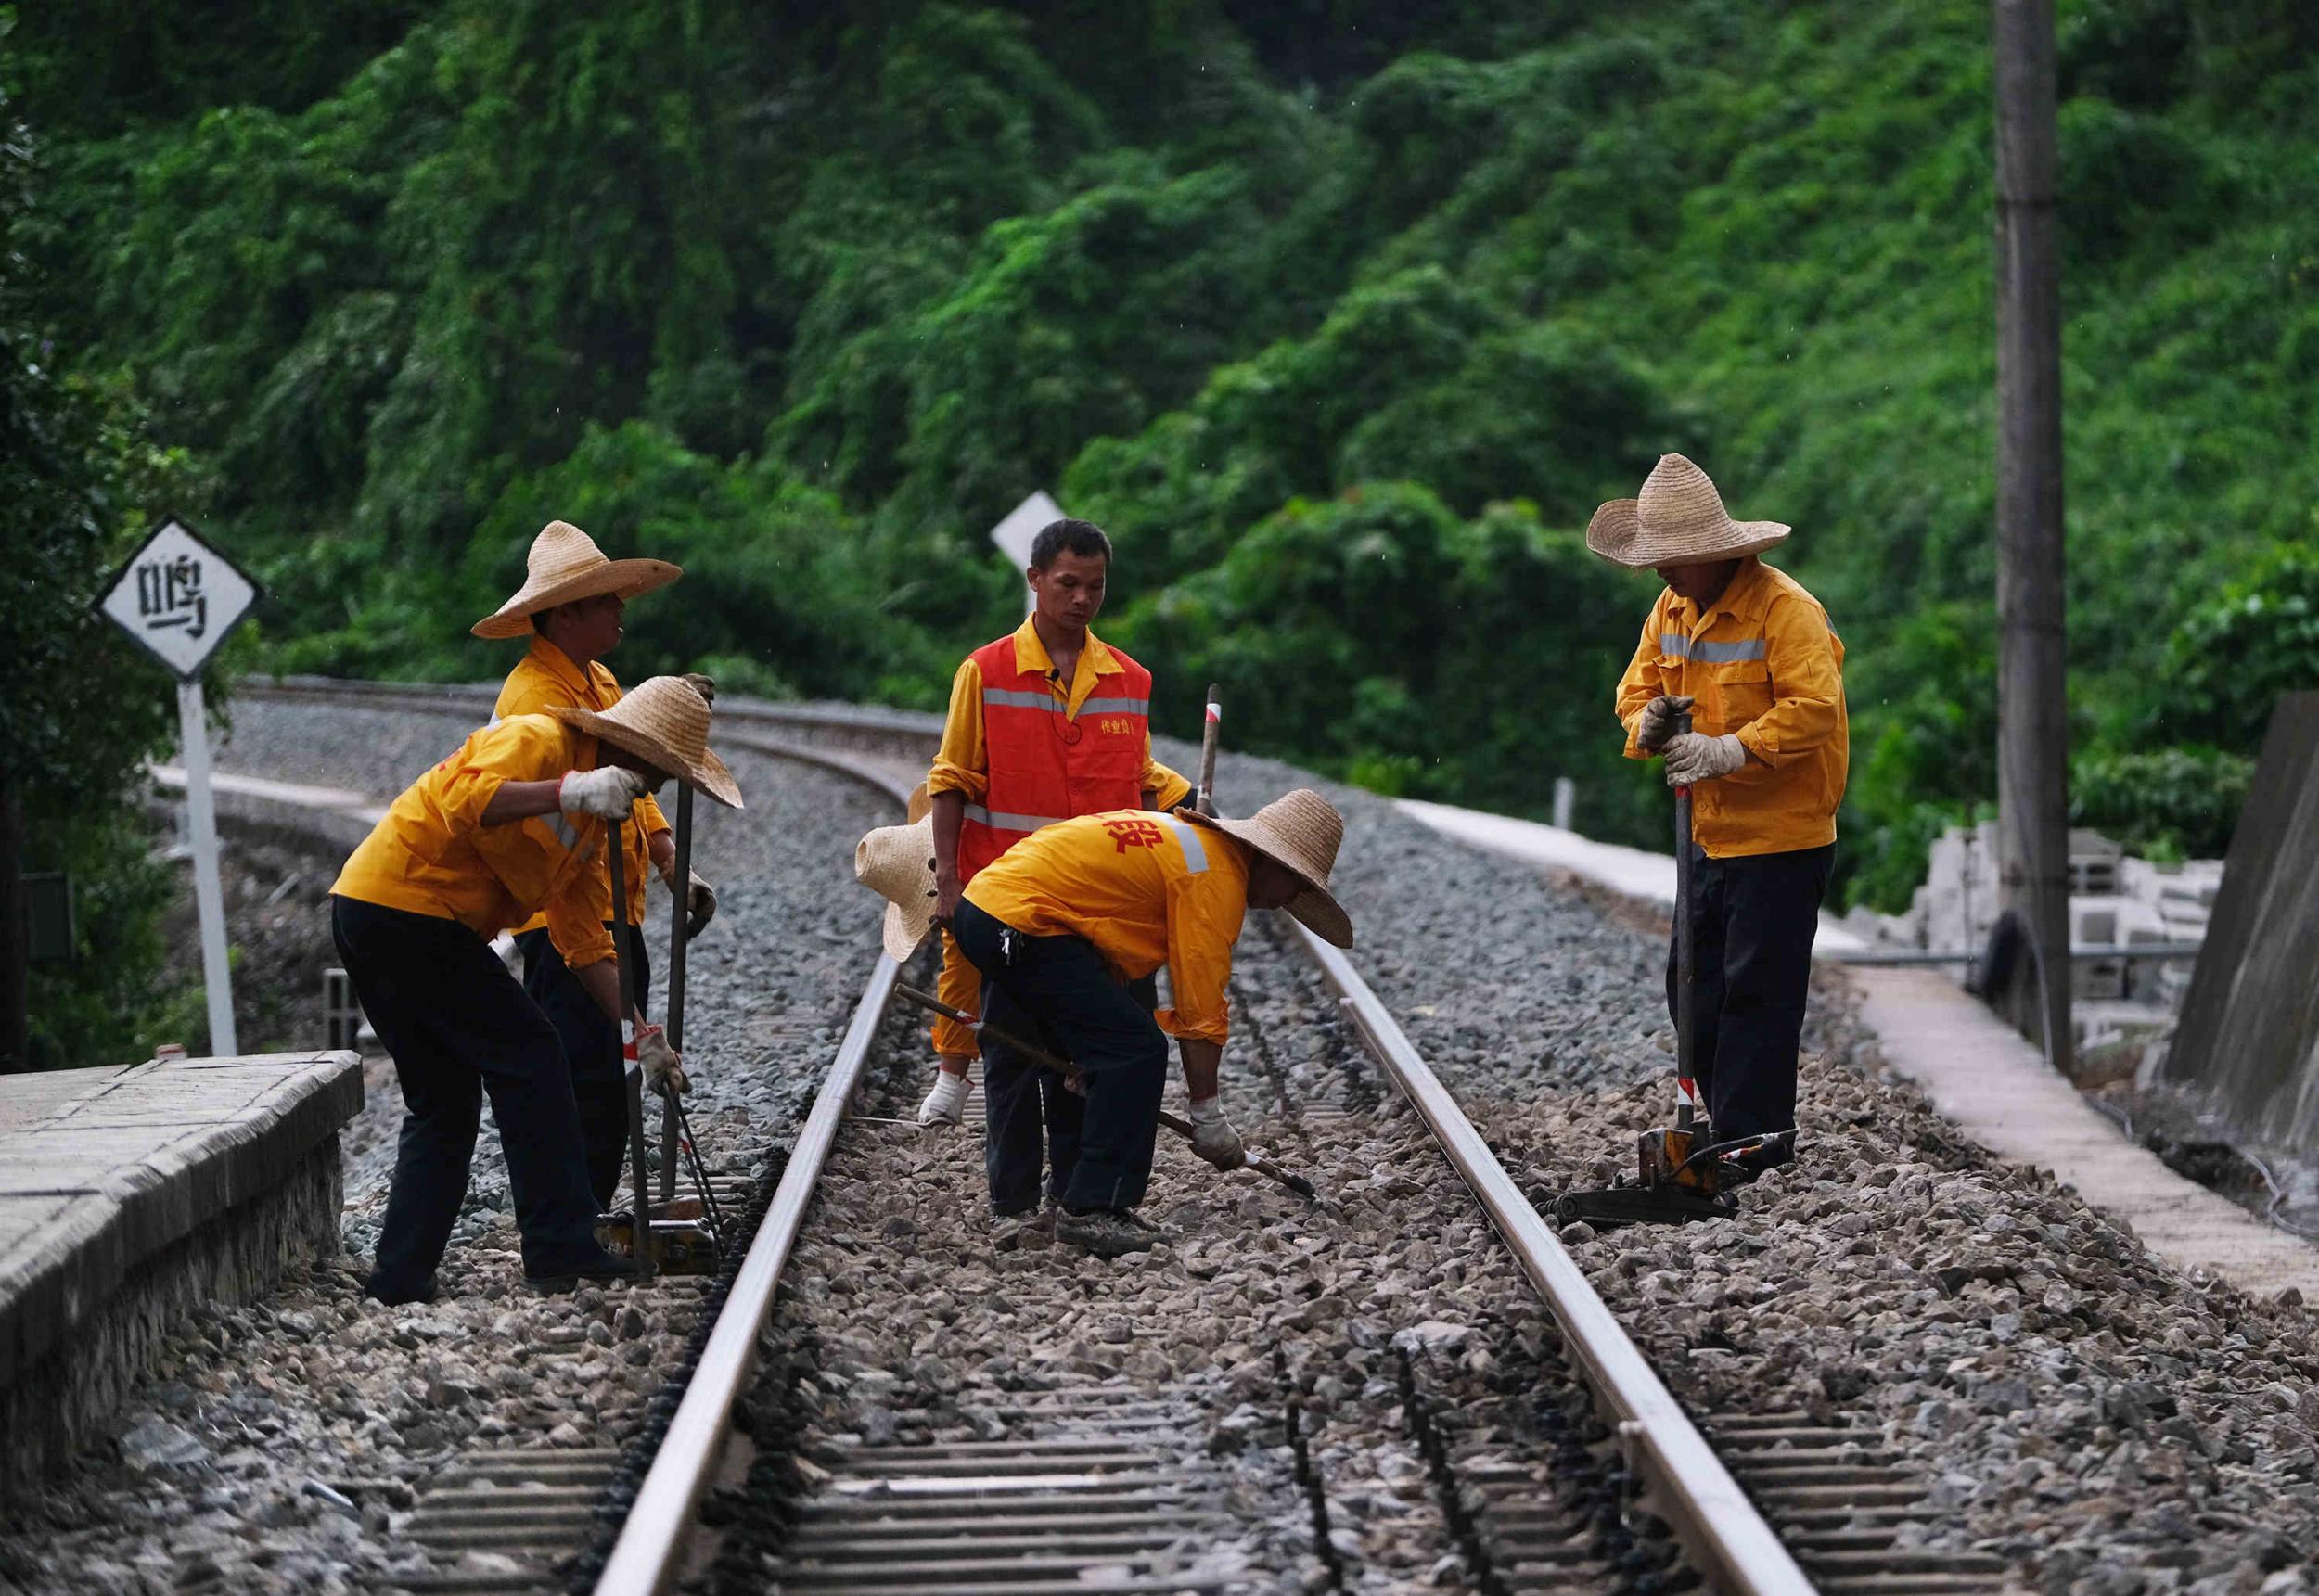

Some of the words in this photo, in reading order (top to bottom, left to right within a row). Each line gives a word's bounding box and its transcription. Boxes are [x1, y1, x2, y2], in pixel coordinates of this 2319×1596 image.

[138, 555, 206, 638] 鸣
[1101, 719, 1134, 735] 作业负
[1092, 810, 1164, 854] 段
